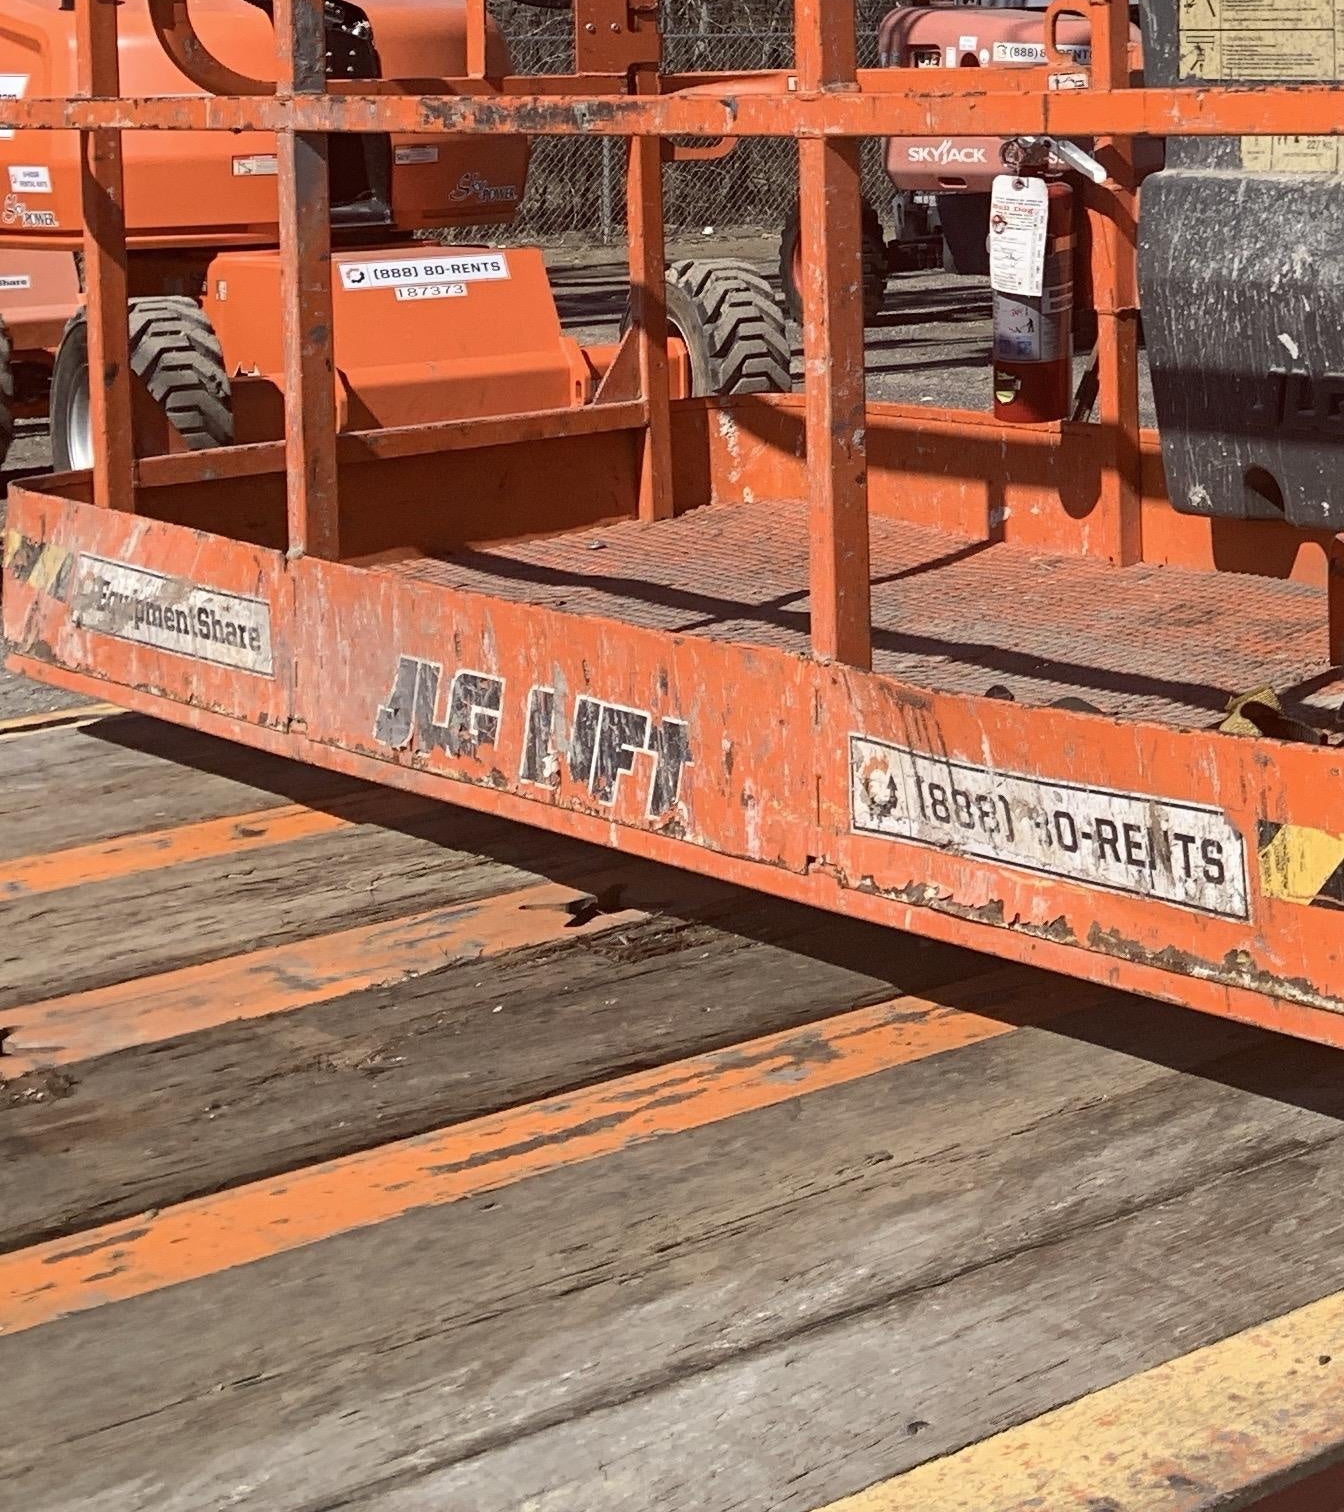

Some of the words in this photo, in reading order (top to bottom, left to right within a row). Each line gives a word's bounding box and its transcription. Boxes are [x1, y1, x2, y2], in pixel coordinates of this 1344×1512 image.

[1009, 46, 1038, 59] (888)
[907, 139, 987, 164] SKYJACK
[373, 267, 418, 280] (888)
[423, 261, 501, 276] 80-RENTS
[374, 654, 505, 758] JLG
